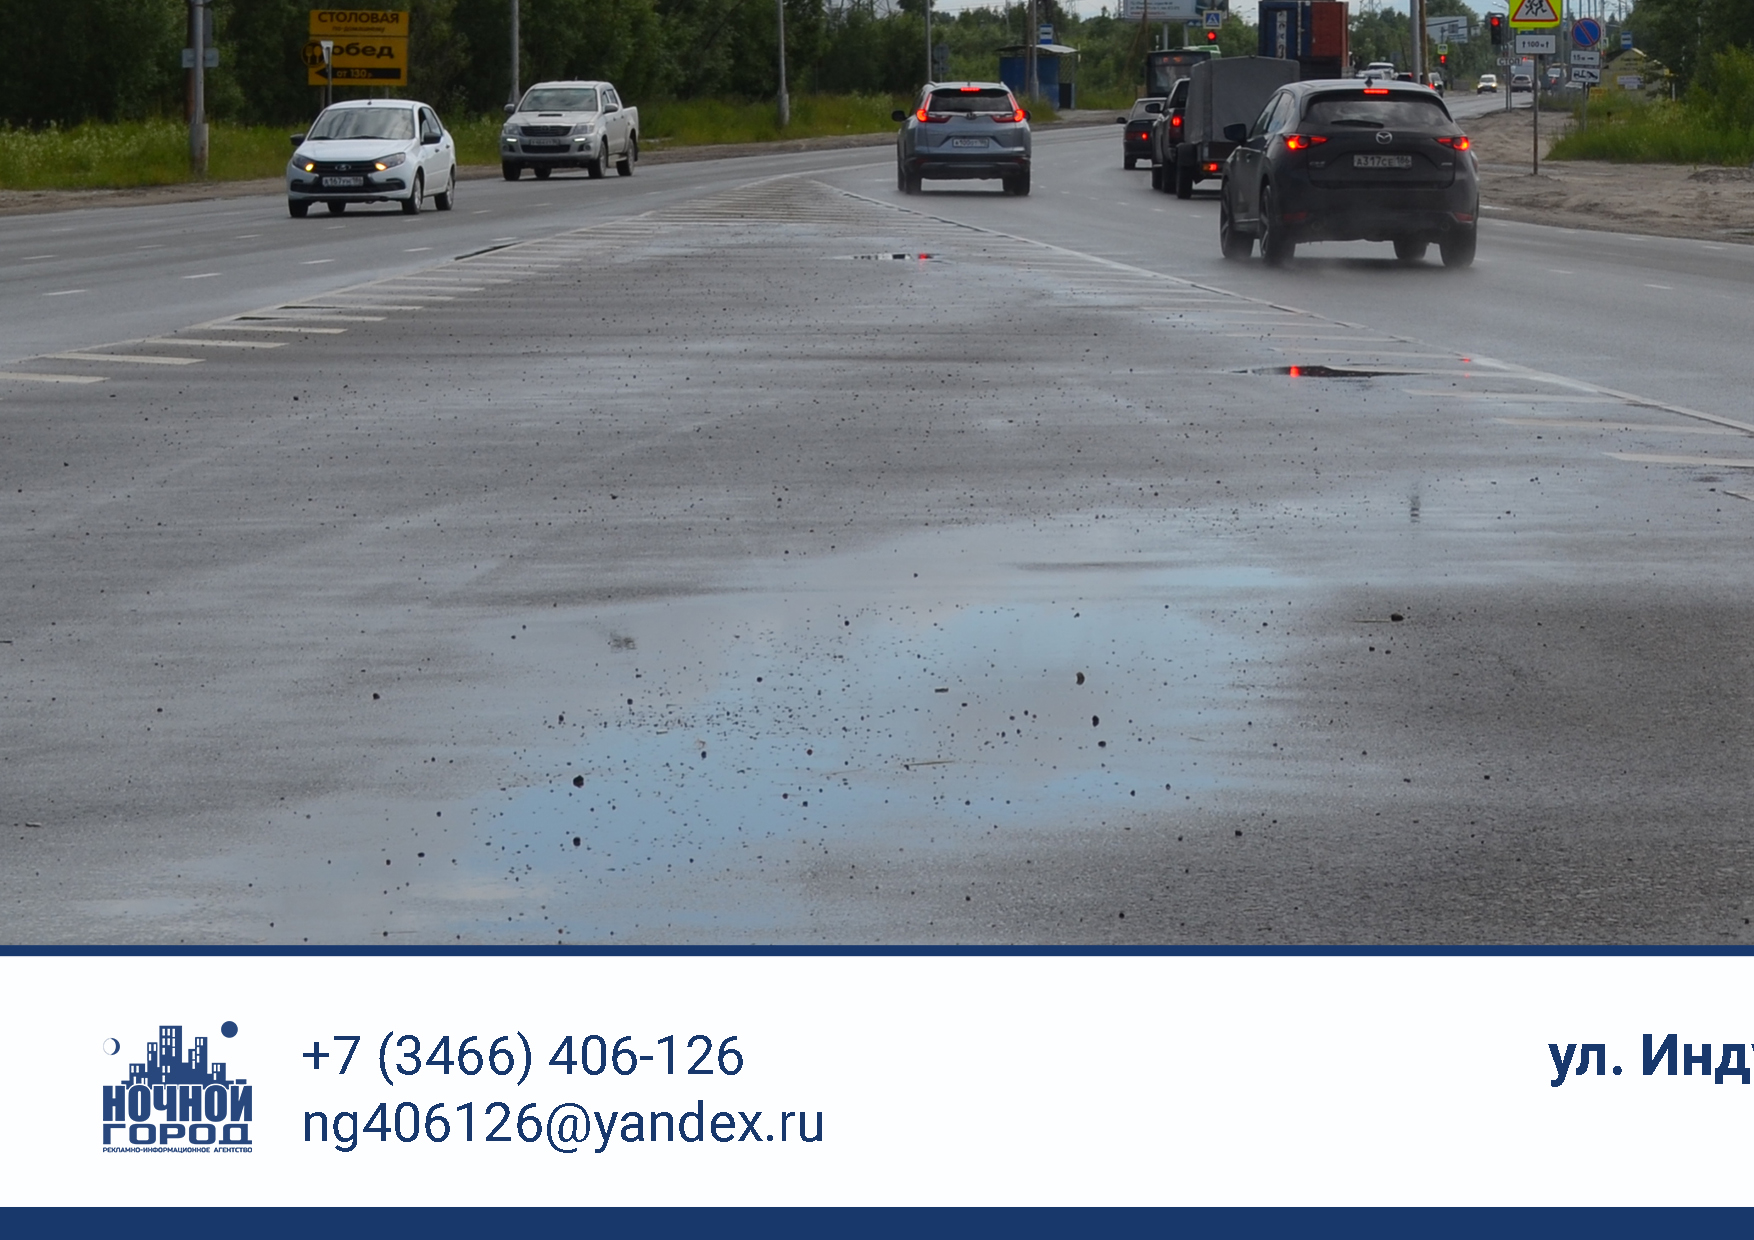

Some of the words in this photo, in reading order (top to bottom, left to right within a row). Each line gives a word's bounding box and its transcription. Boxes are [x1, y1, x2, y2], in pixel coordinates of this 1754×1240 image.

[318, 12, 399, 24] СТОЛОВАЯ
[332, 42, 394, 59] обед
[350, 69, 367, 78] 130
